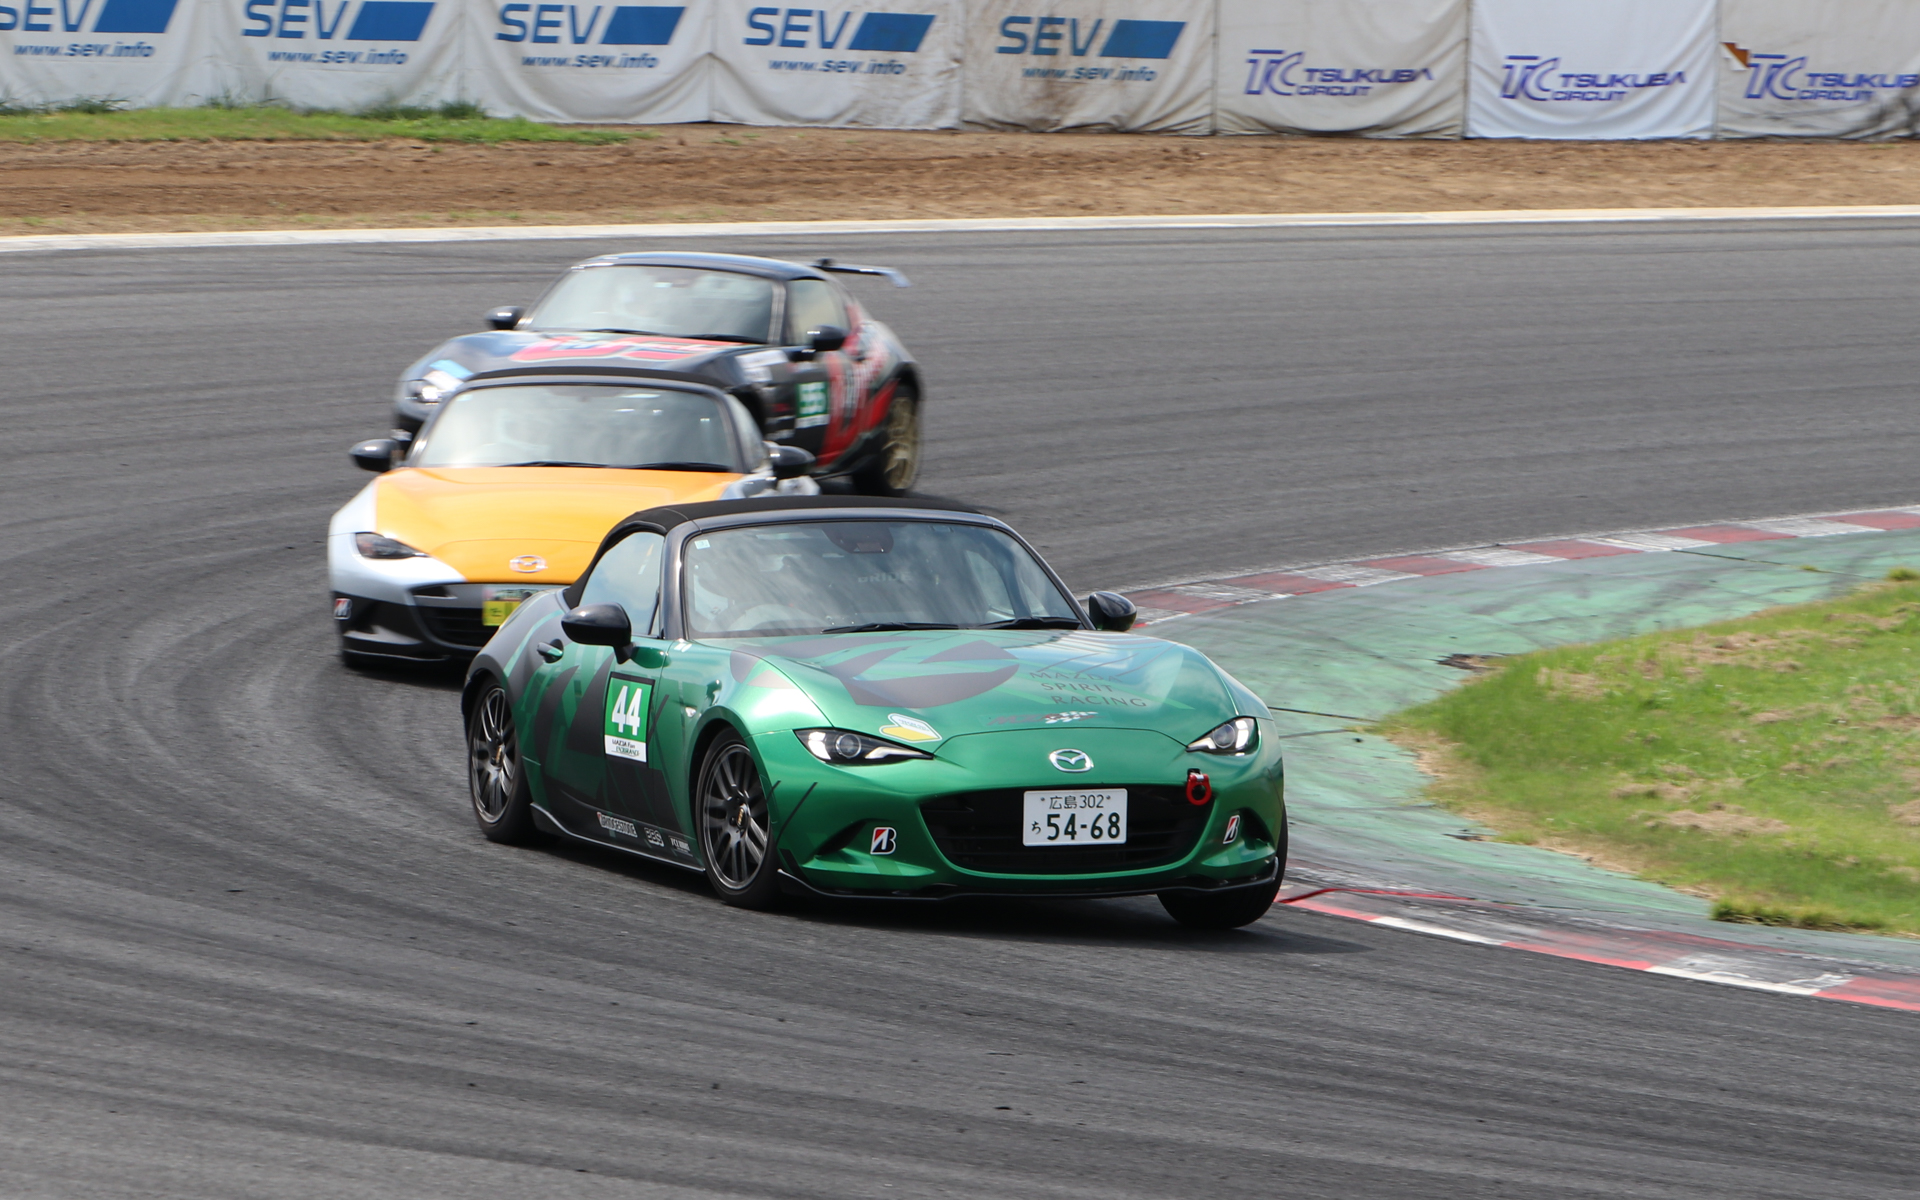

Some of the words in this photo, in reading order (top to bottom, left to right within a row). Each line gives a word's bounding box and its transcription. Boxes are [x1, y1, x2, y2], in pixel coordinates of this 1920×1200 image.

[242, 0, 349, 39] SEV
[494, 3, 602, 44] SEV
[743, 7, 851, 49] SEV
[996, 15, 1102, 56] SEV
[14, 41, 156, 57] www.sev.info
[267, 49, 407, 64] www.sev.info
[521, 53, 659, 68] www.sev.info
[768, 59, 906, 75] www.sev.info
[1022, 66, 1157, 81] www.sev.info
[1303, 68, 1435, 83] TSUKUBA
[1558, 71, 1687, 88] TSUKUBA
[1805, 73, 1920, 88] TSUKUB
[1298, 85, 1373, 96] CIRCUIT
[1552, 91, 1628, 101] CIRCUIT
[1798, 90, 1875, 101] CIRCUIT
[1030, 672, 1122, 682] MAZDA
[1041, 682, 1113, 693] SPIRIT
[1051, 695, 1147, 708] RACING
[611, 685, 643, 736] 44
[1031, 821, 1041, 834] ち
[1047, 812, 1120, 840] 54-68
